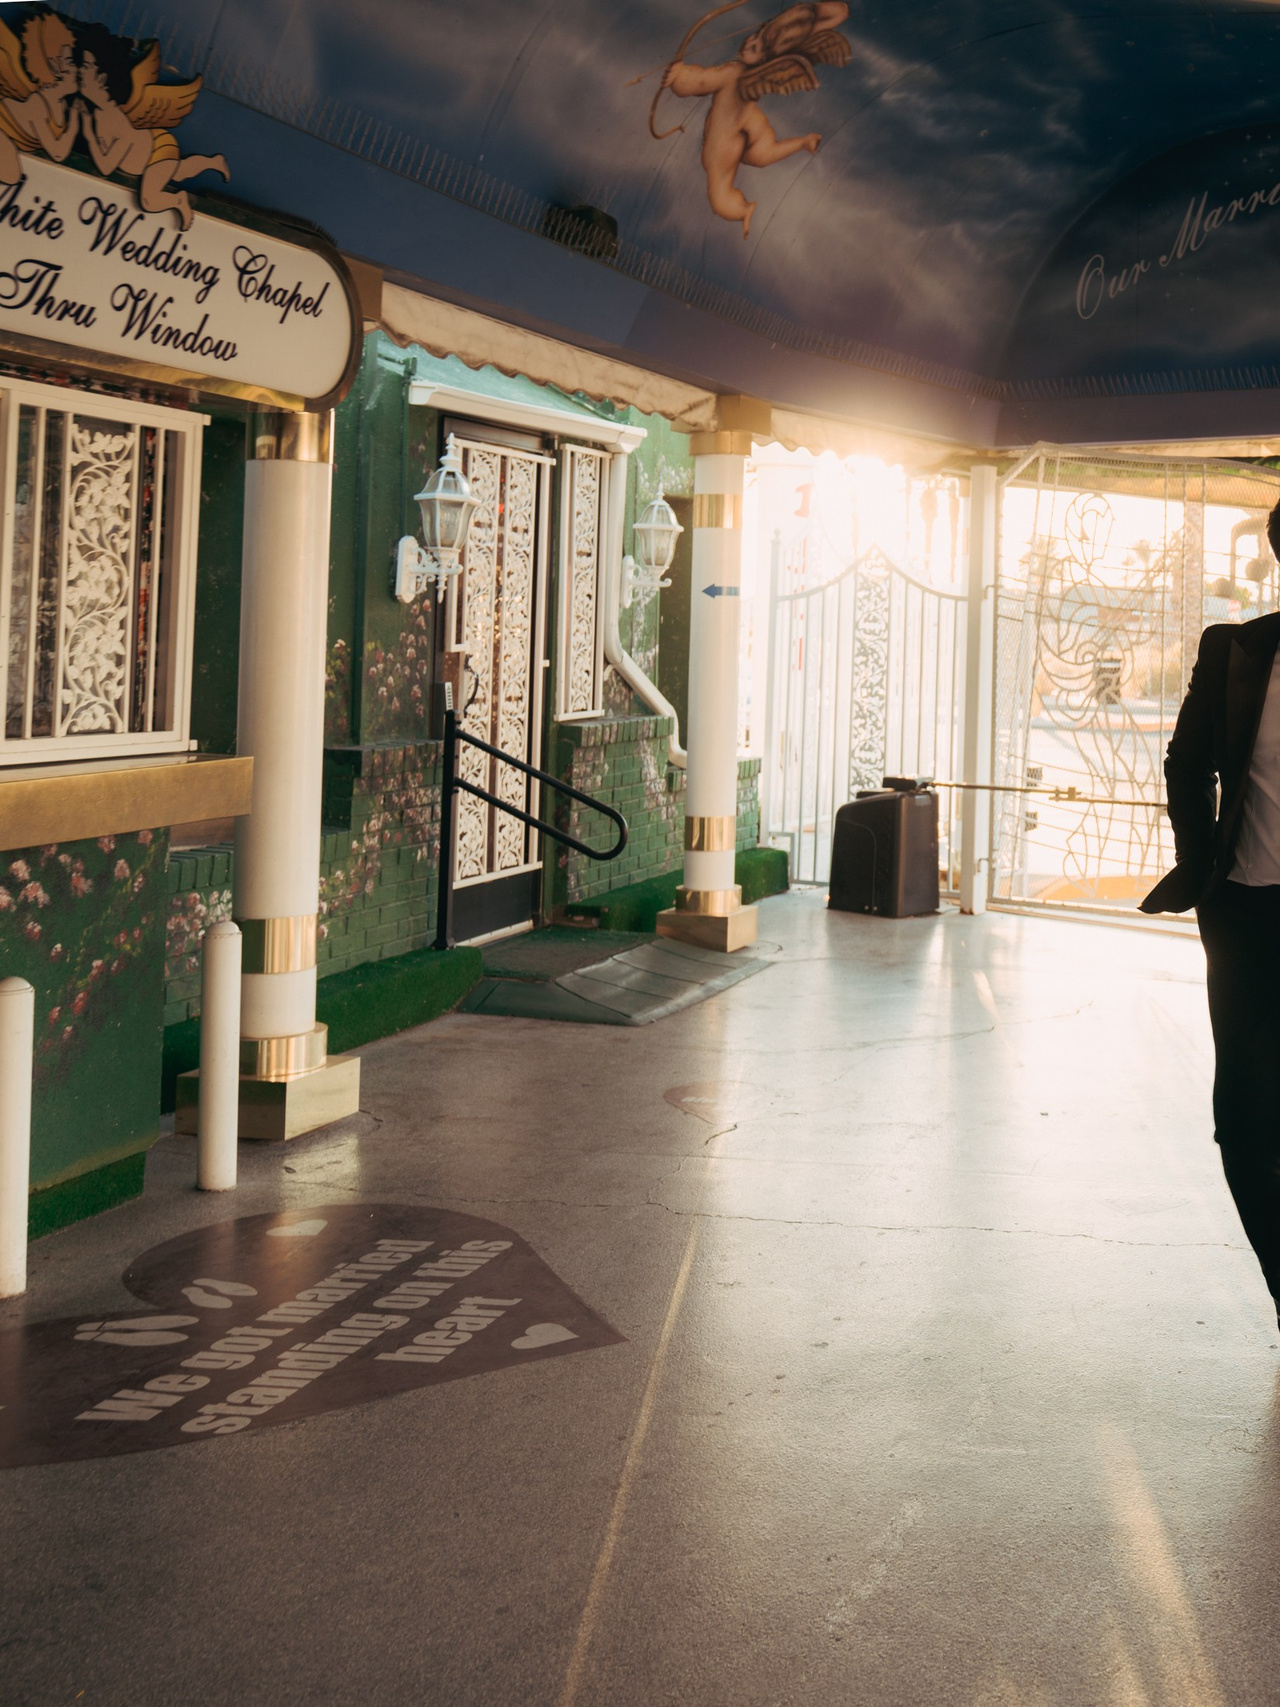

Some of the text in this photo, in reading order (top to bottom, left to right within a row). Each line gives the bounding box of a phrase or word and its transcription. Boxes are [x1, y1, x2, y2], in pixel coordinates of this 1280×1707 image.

[0, 258, 238, 361] Thru Window
[78, 197, 220, 303] Wedding
[233, 246, 330, 324] Chapel
[1076, 254, 1151, 319] Our
[74, 1239, 435, 1420] We got married
[180, 1240, 514, 1434] standing on this
[374, 1296, 523, 1363] heart
